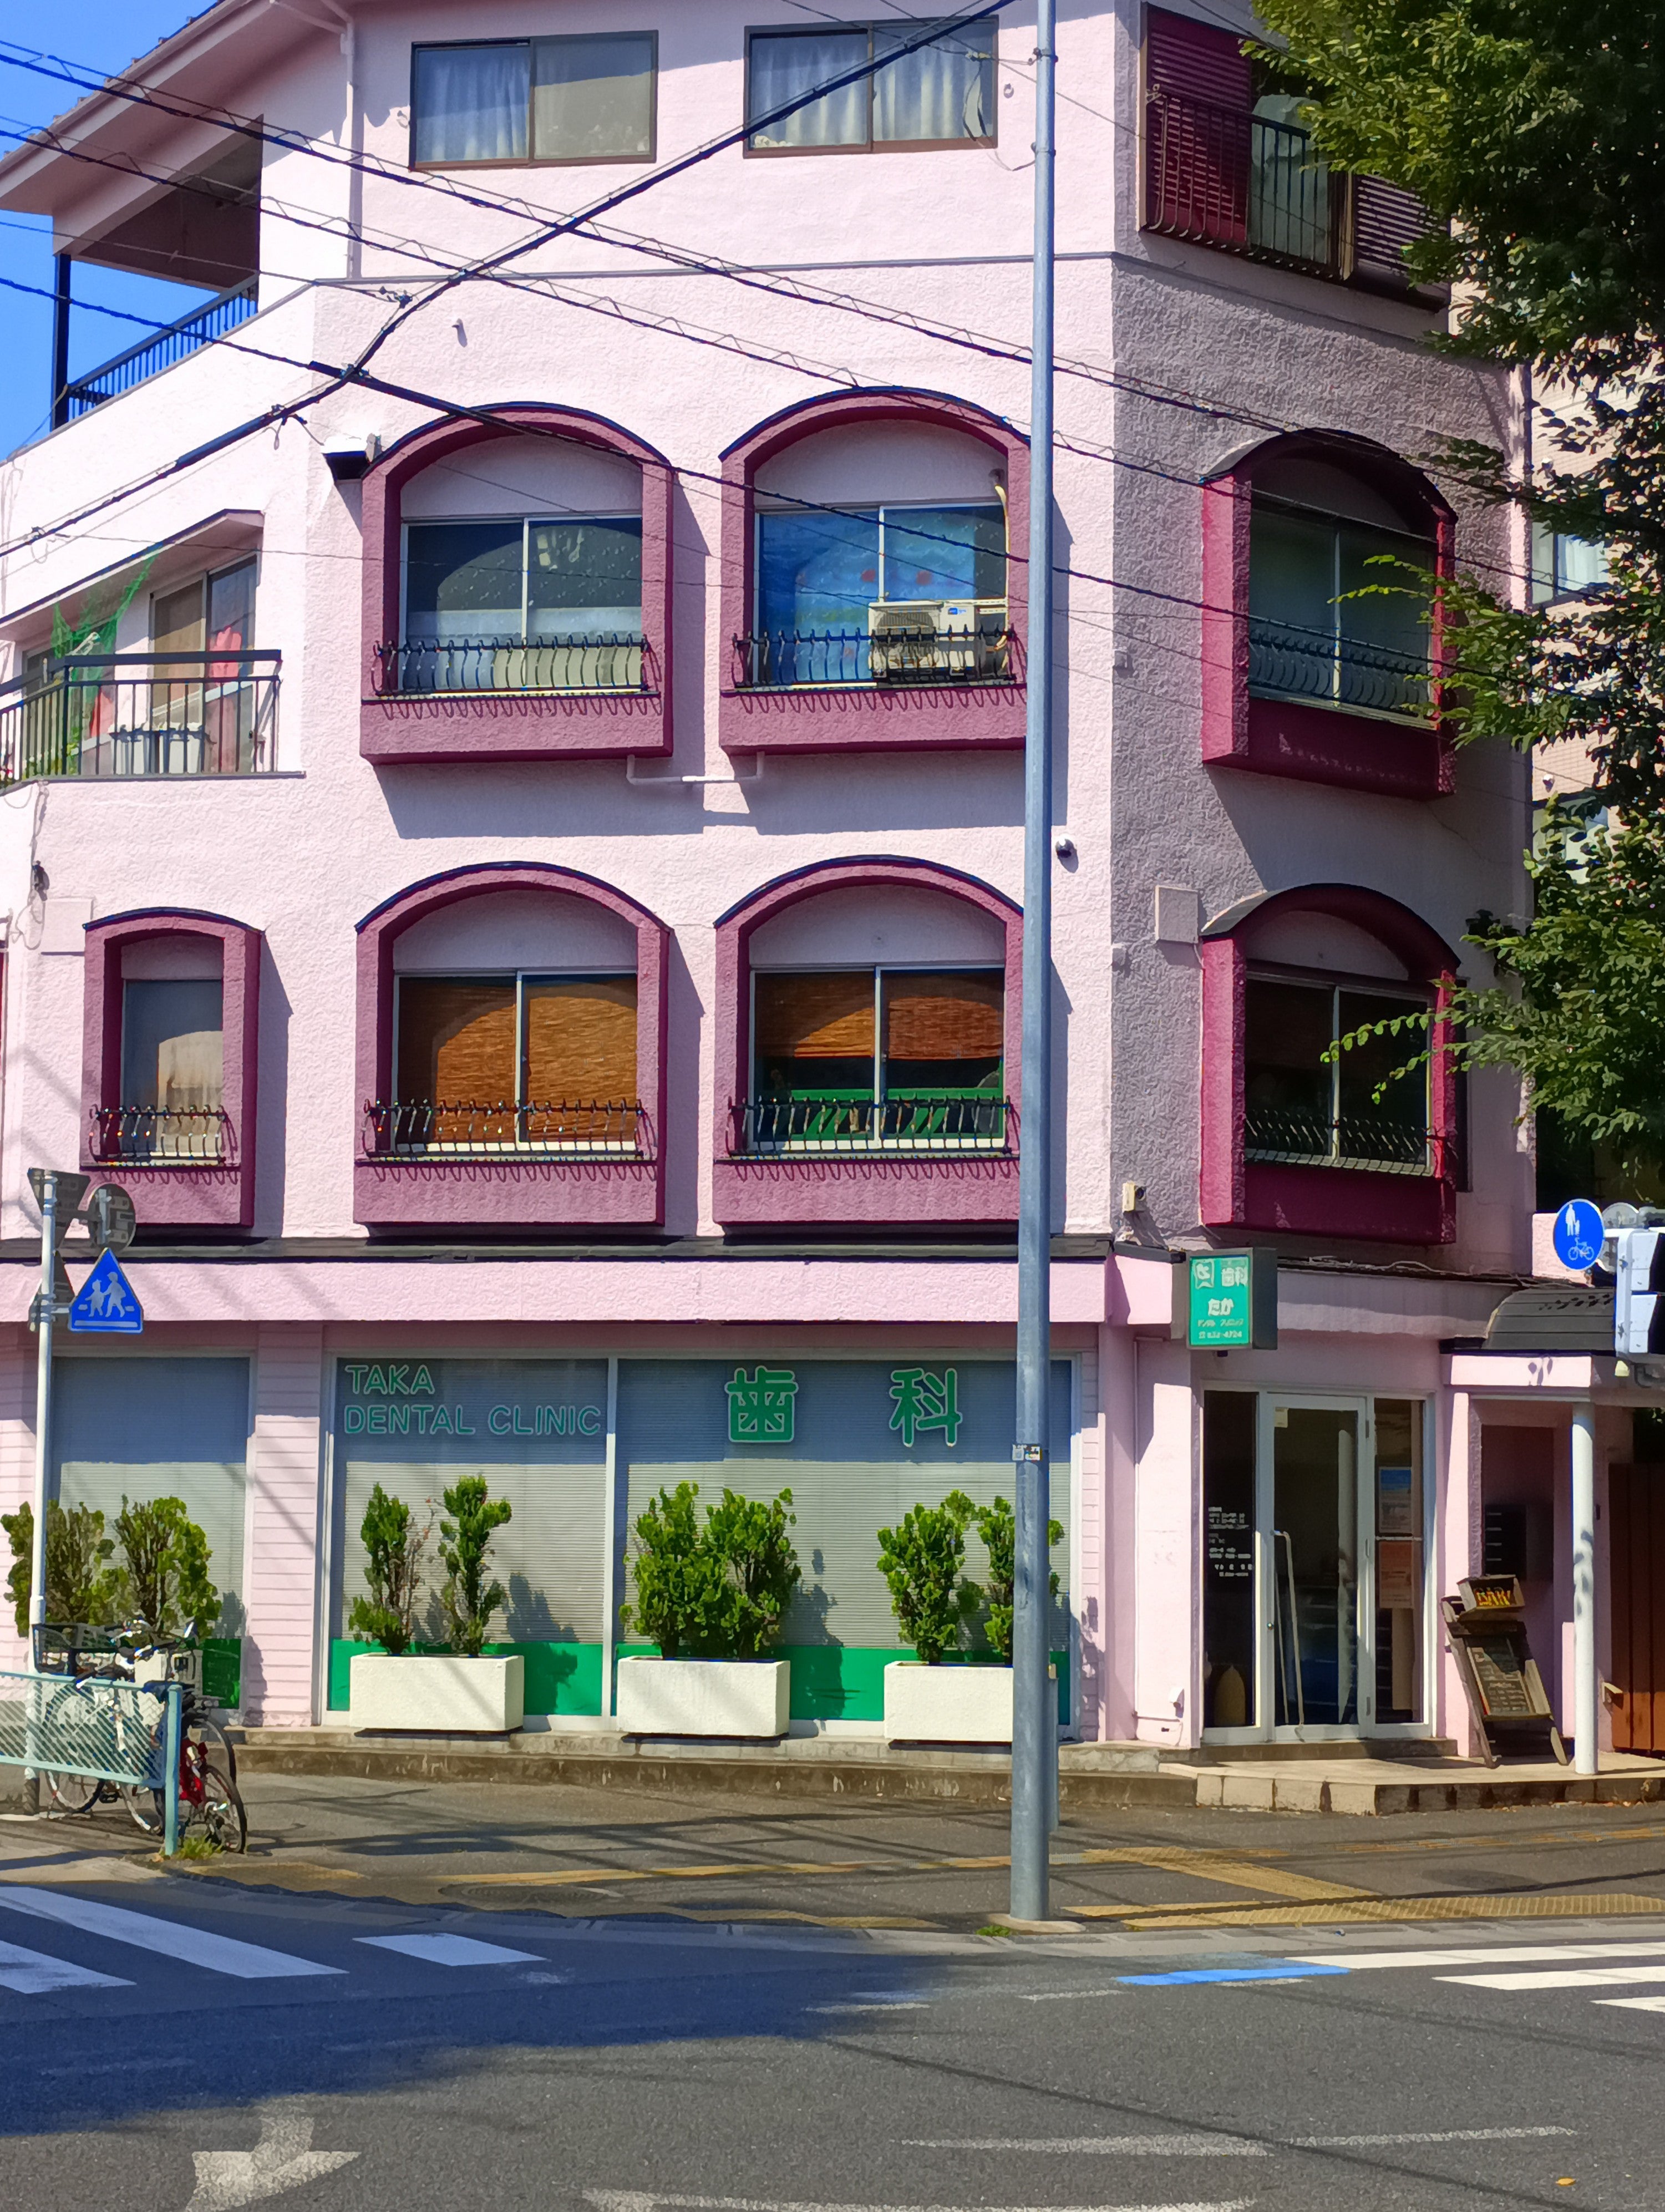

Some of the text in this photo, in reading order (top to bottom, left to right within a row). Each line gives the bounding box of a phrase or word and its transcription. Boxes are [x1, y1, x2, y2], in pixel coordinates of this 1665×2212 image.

[345, 1364, 435, 1395] TAKA
[344, 1404, 601, 1435] DENTAL CLINIC
